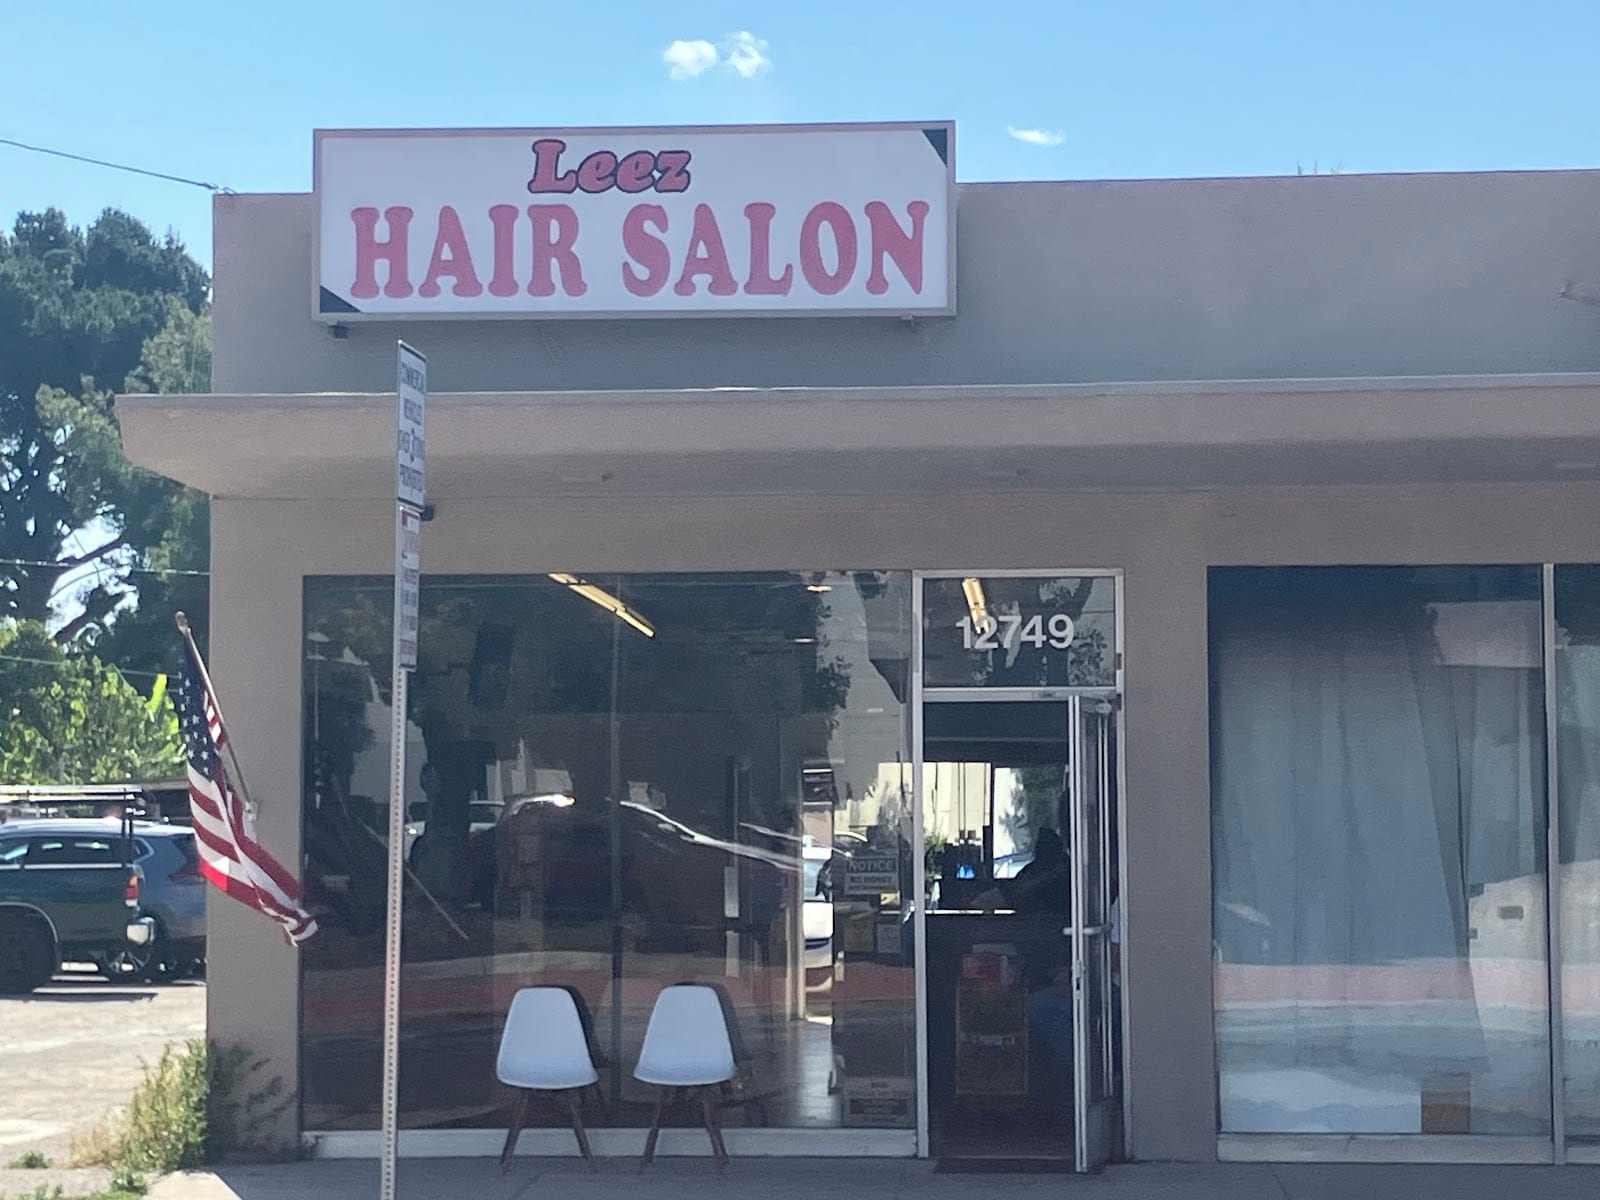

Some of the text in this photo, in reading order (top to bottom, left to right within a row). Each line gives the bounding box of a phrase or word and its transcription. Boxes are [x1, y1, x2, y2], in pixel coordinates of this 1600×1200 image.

[528, 139, 692, 194] Leez
[350, 201, 930, 299] HAIR SALON
[955, 613, 1075, 650] 12749
[848, 860, 894, 872] NOTICE
